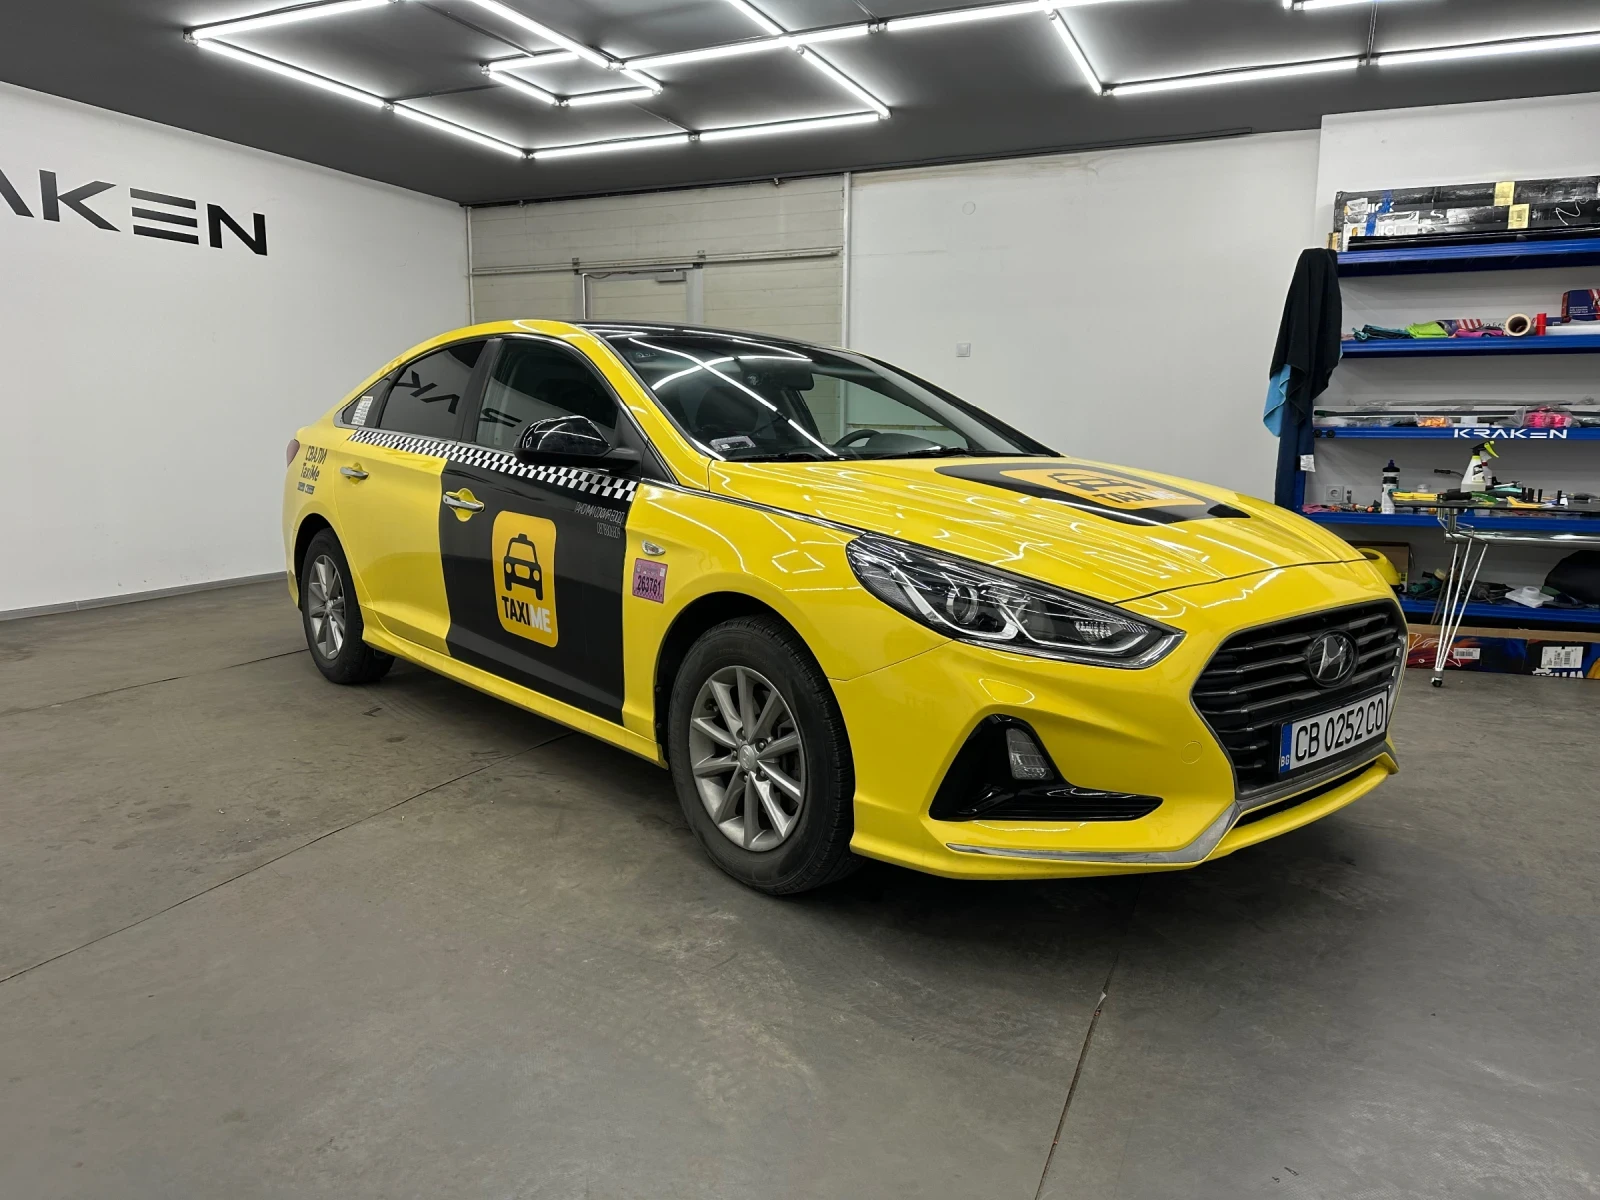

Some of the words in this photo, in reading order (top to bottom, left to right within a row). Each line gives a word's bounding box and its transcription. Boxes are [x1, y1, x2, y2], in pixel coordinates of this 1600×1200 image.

[1453, 428, 1568, 439] KRAKEN
[636, 575, 662, 597] 263761
[501, 595, 552, 634] TAXIME
[1295, 721, 1320, 762] CB
[1324, 706, 1364, 752] 0252
[1366, 698, 1384, 735] CO
[1280, 754, 1290, 768] BG
